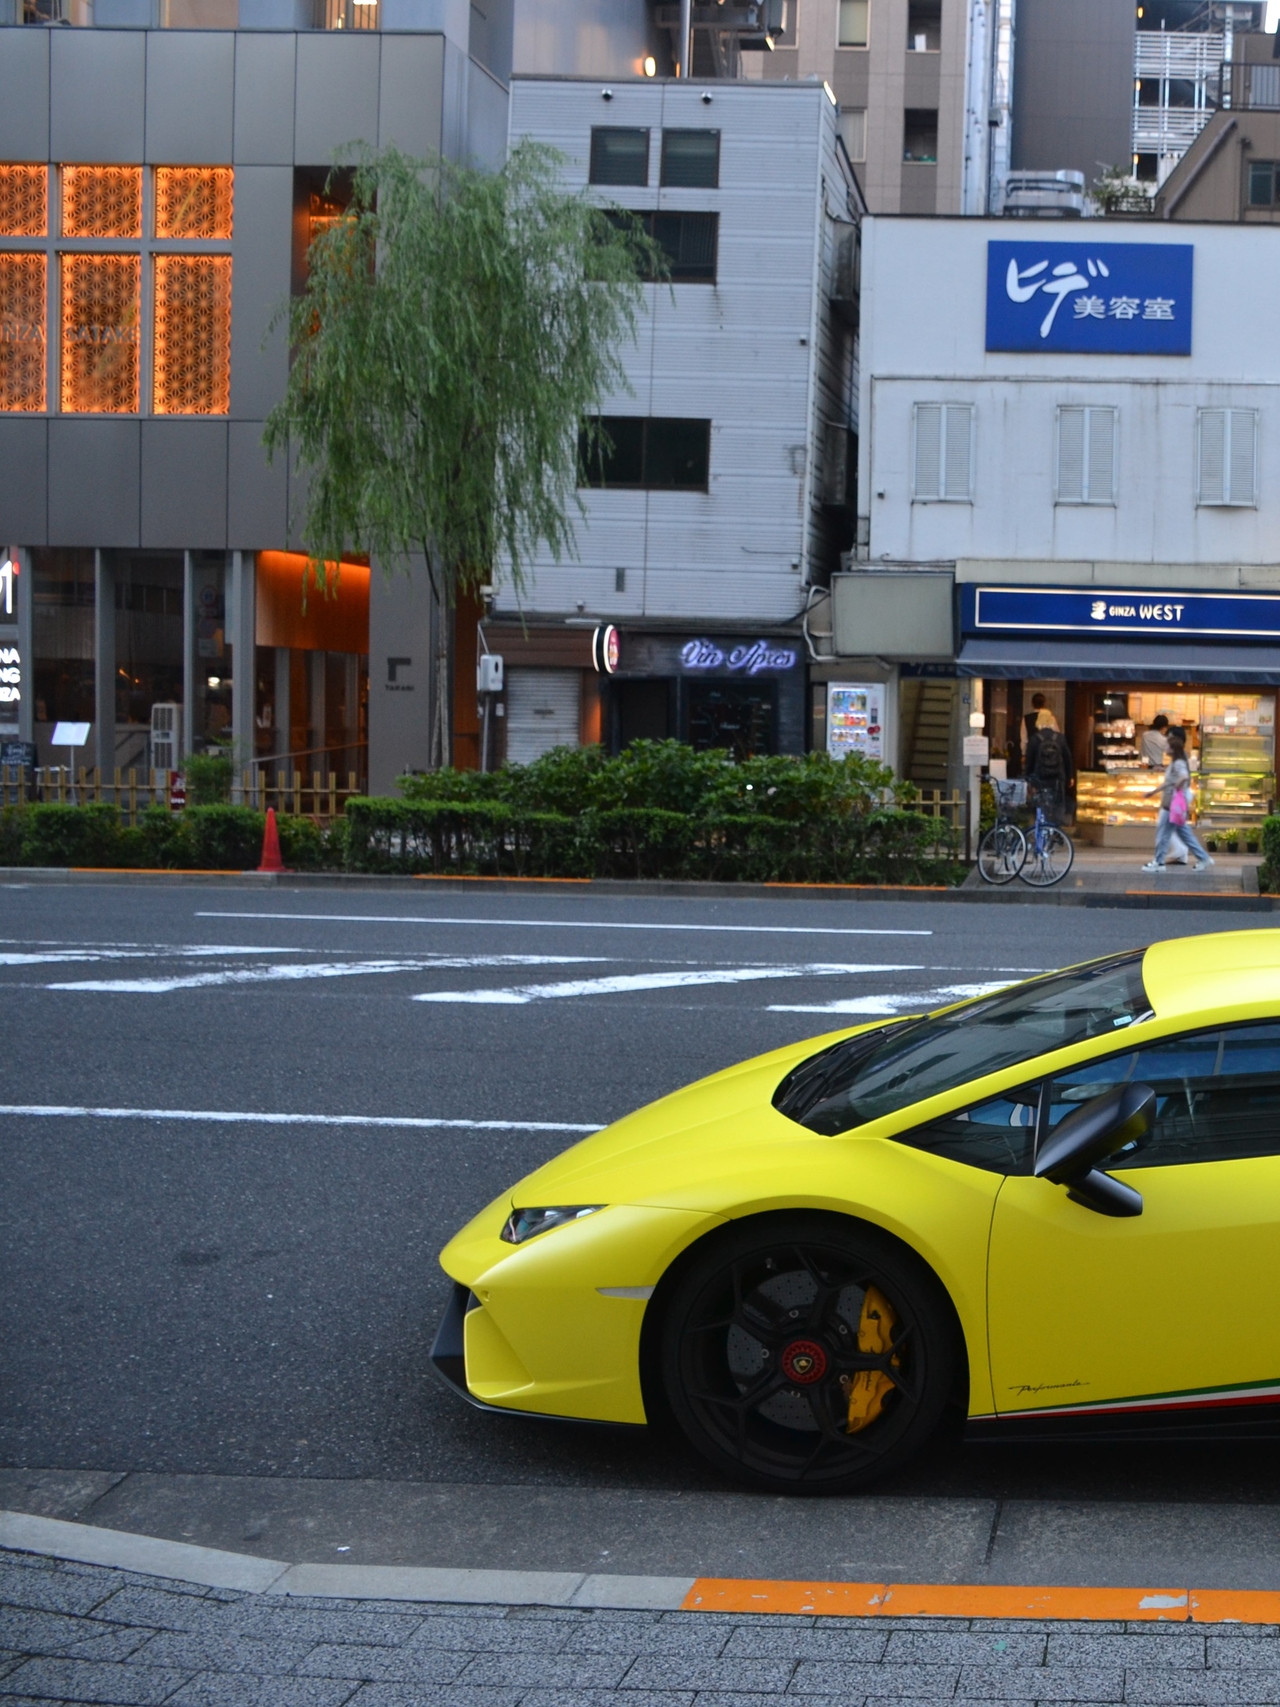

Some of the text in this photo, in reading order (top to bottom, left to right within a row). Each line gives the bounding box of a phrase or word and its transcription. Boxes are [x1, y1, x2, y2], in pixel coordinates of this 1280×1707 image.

[1006, 258, 1109, 339] ヒデ
[1073, 295, 1176, 320] 美容室
[1109, 603, 1185, 622] GINZA WEST
[682, 639, 722, 667] Vin
